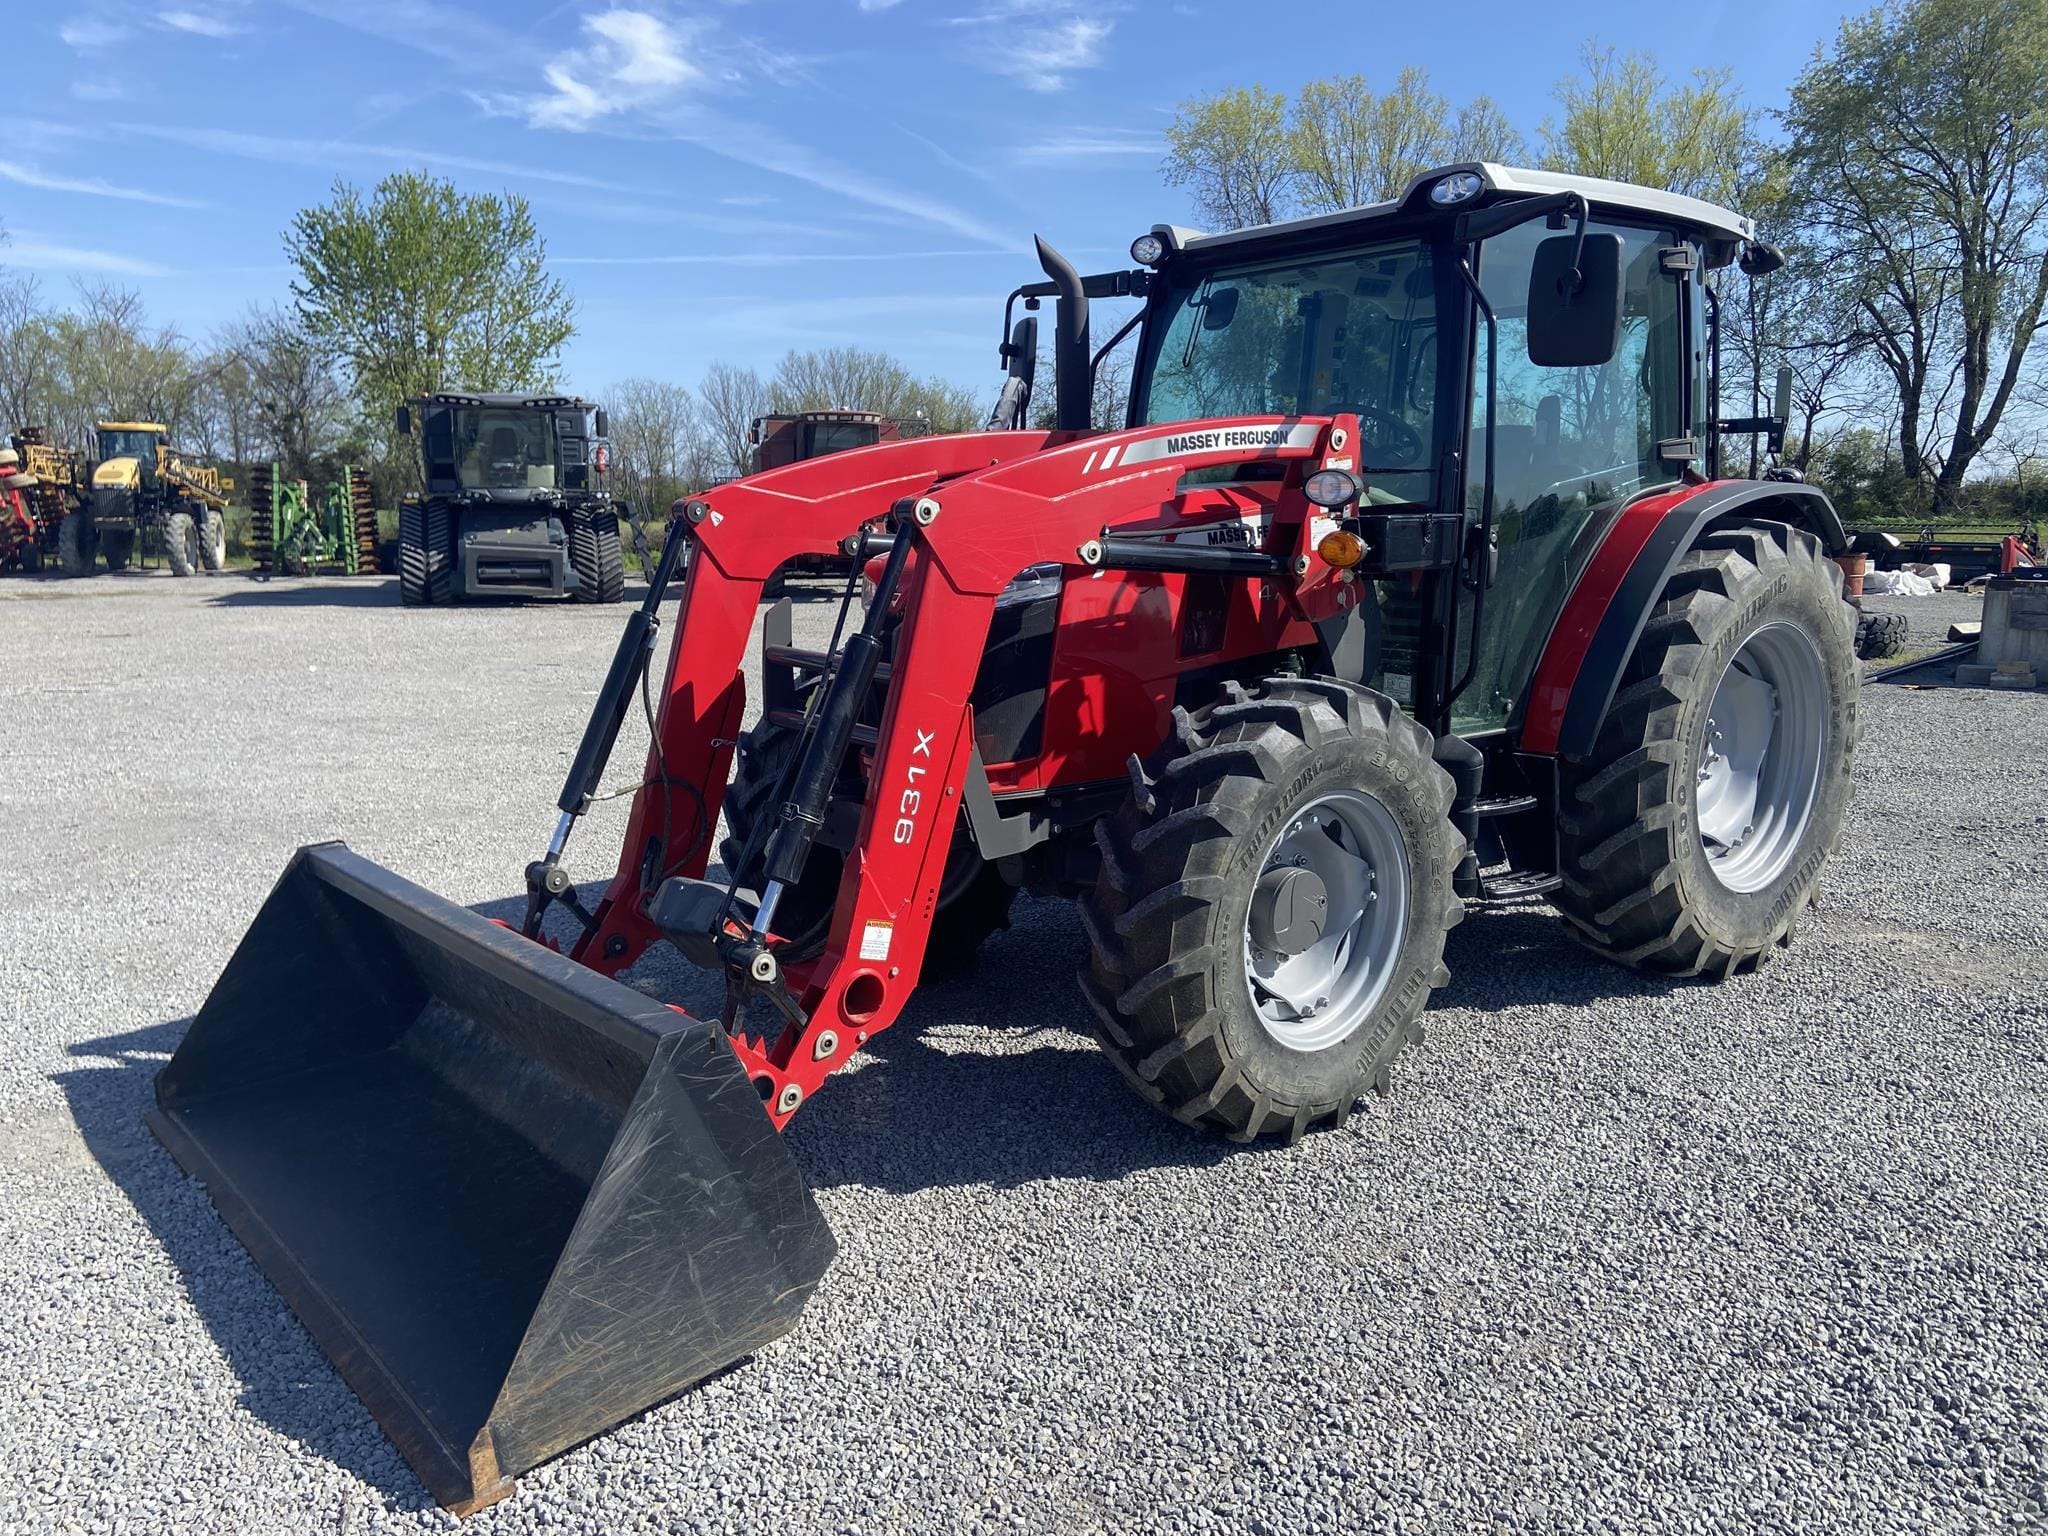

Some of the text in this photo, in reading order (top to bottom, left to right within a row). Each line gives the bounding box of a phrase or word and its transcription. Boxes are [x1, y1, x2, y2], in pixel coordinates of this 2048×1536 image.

[1167, 430, 1289, 454] MASSEY FERGUSON
[1207, 529, 1249, 546] MASSE
[1237, 756, 1323, 871] TRELLEBORG
[1355, 966, 1427, 1077] TRELLEBORG
